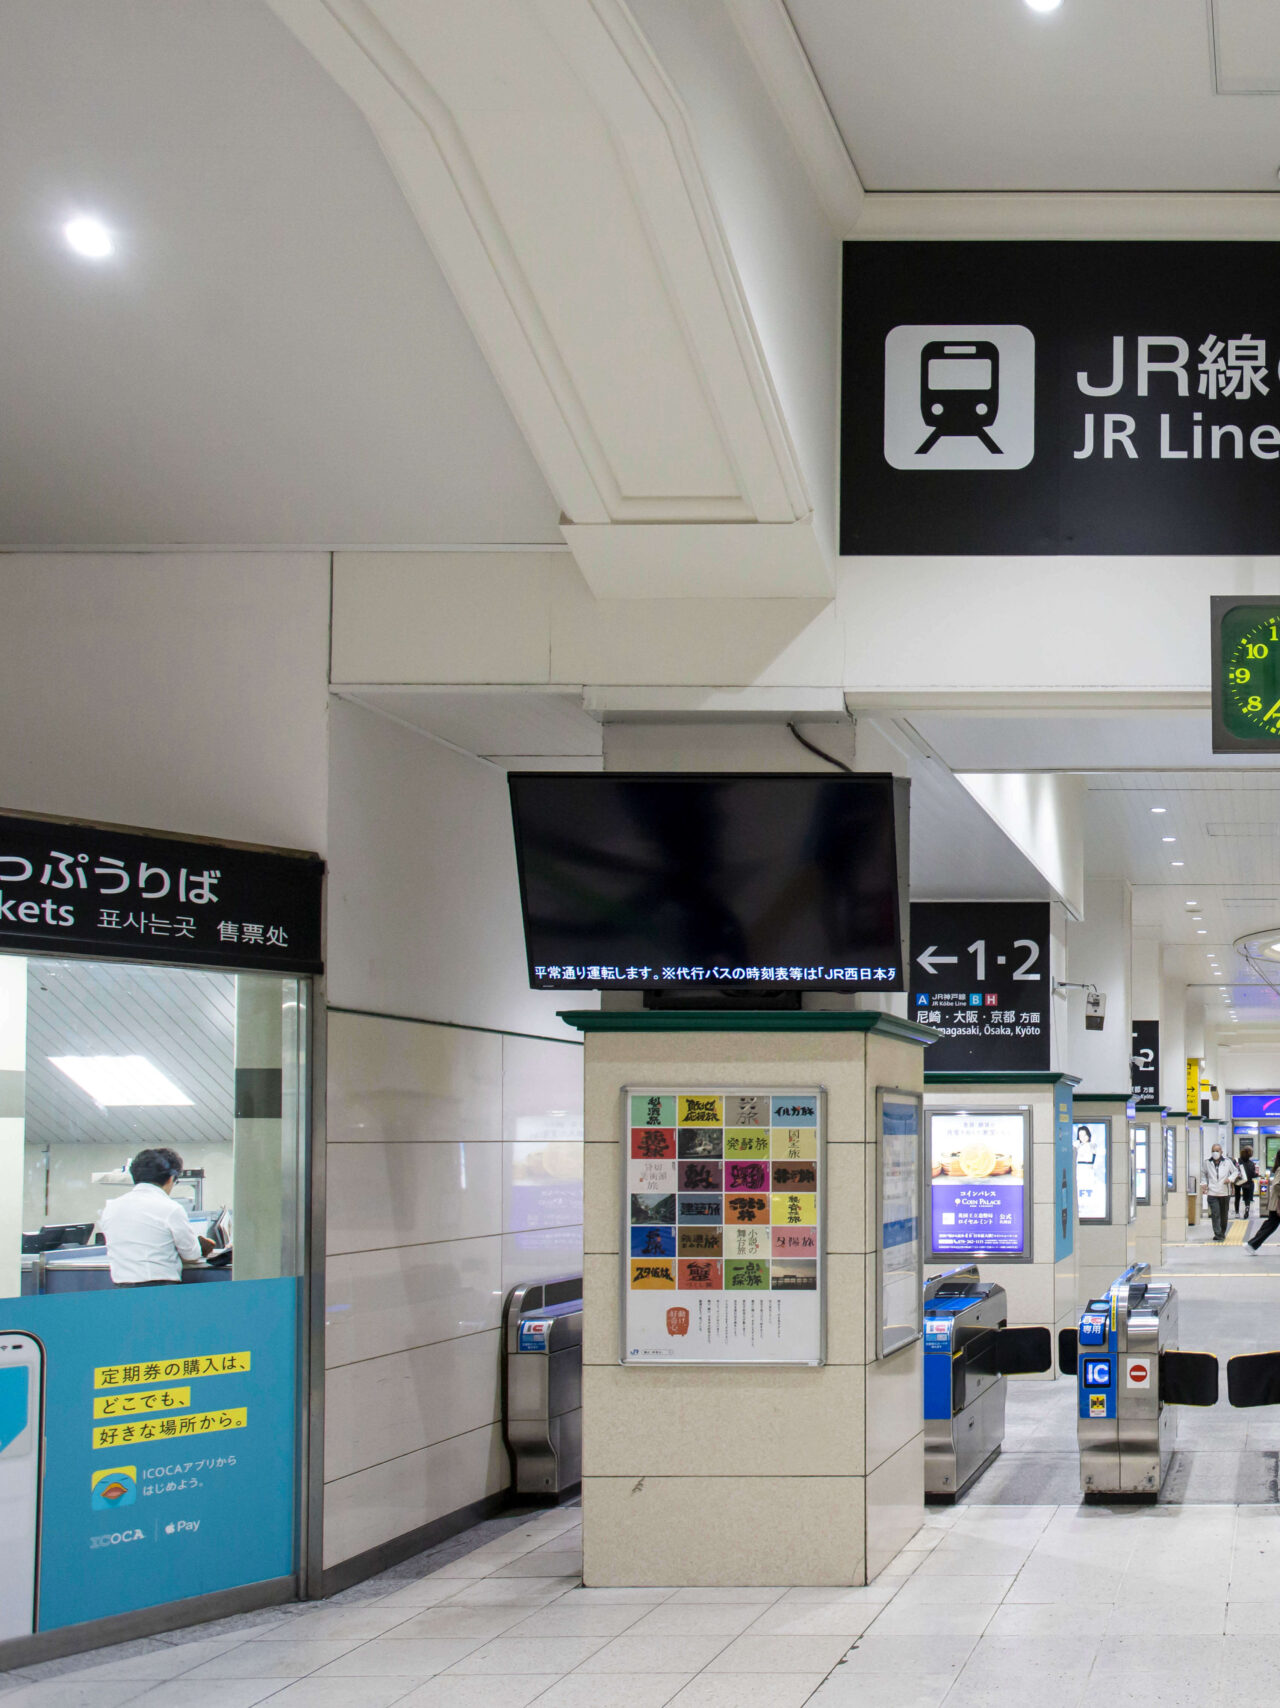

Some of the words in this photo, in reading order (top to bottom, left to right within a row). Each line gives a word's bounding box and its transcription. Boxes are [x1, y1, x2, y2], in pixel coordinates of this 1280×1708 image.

[1074, 413, 1138, 459] JR
[1246, 644, 1268, 659] 10
[1235, 668, 1250, 684] 9
[1248, 696, 1262, 712] 8
[97, 908, 198, 939] 표사는곳
[216, 920, 289, 948] 售票处
[1020, 1011, 1041, 1024] 方面
[1083, 1325, 1101, 1335] 専用
[101, 1356, 247, 1386] 定期券の購入は、
[1088, 1364, 1109, 1383] IC
[103, 1390, 186, 1415] どこでも、
[100, 1412, 244, 1446] 好きな場所から。
[142, 1455, 238, 1480] ICOCAアプリから
[142, 1477, 205, 1497] はじめよう。
[177, 1519, 201, 1533] Pay
